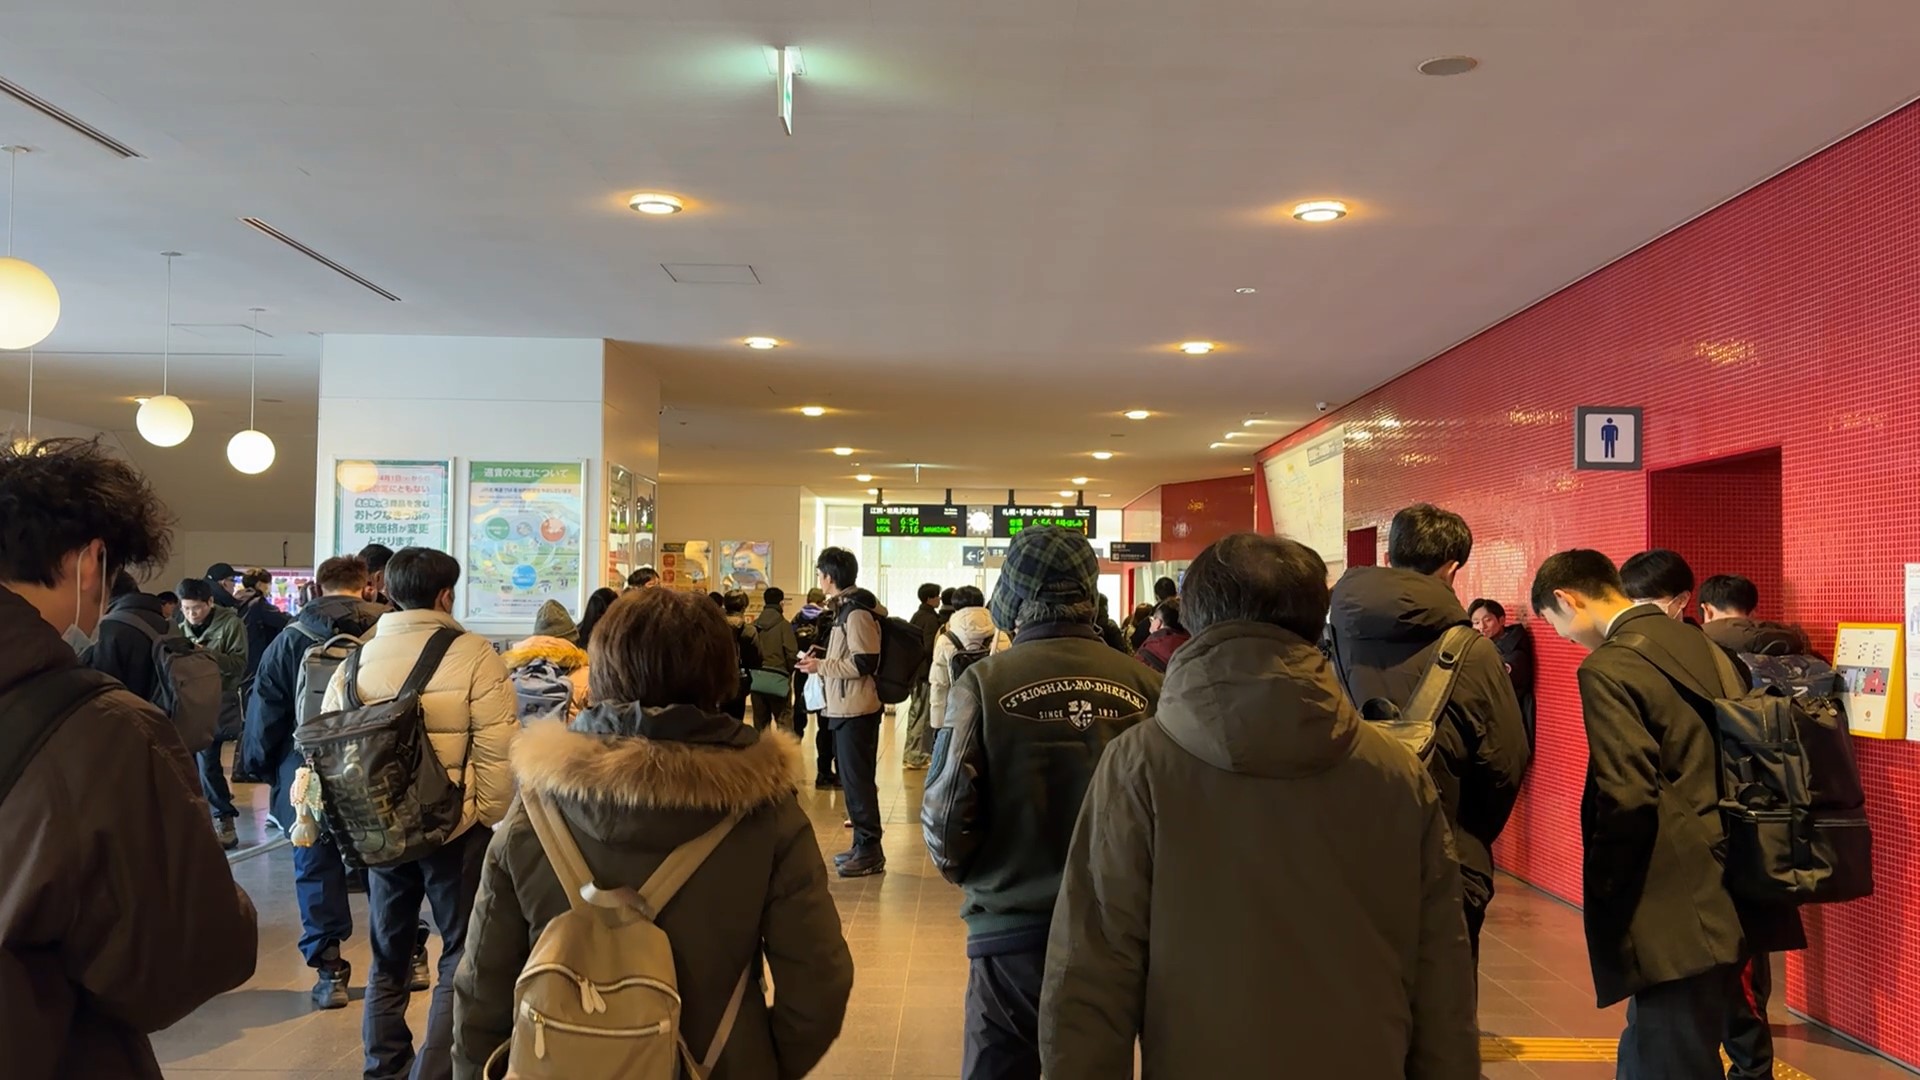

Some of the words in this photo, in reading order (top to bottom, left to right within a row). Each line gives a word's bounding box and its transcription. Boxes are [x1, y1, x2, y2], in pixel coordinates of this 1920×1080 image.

[484, 467, 569, 478] 運賃の改定について
[900, 517, 919, 525] 6:54
[354, 523, 430, 534] 発売価格が変更
[900, 526, 919, 534] 7:16
[950, 526, 957, 534] 2
[1039, 709, 1064, 719] SINCE
